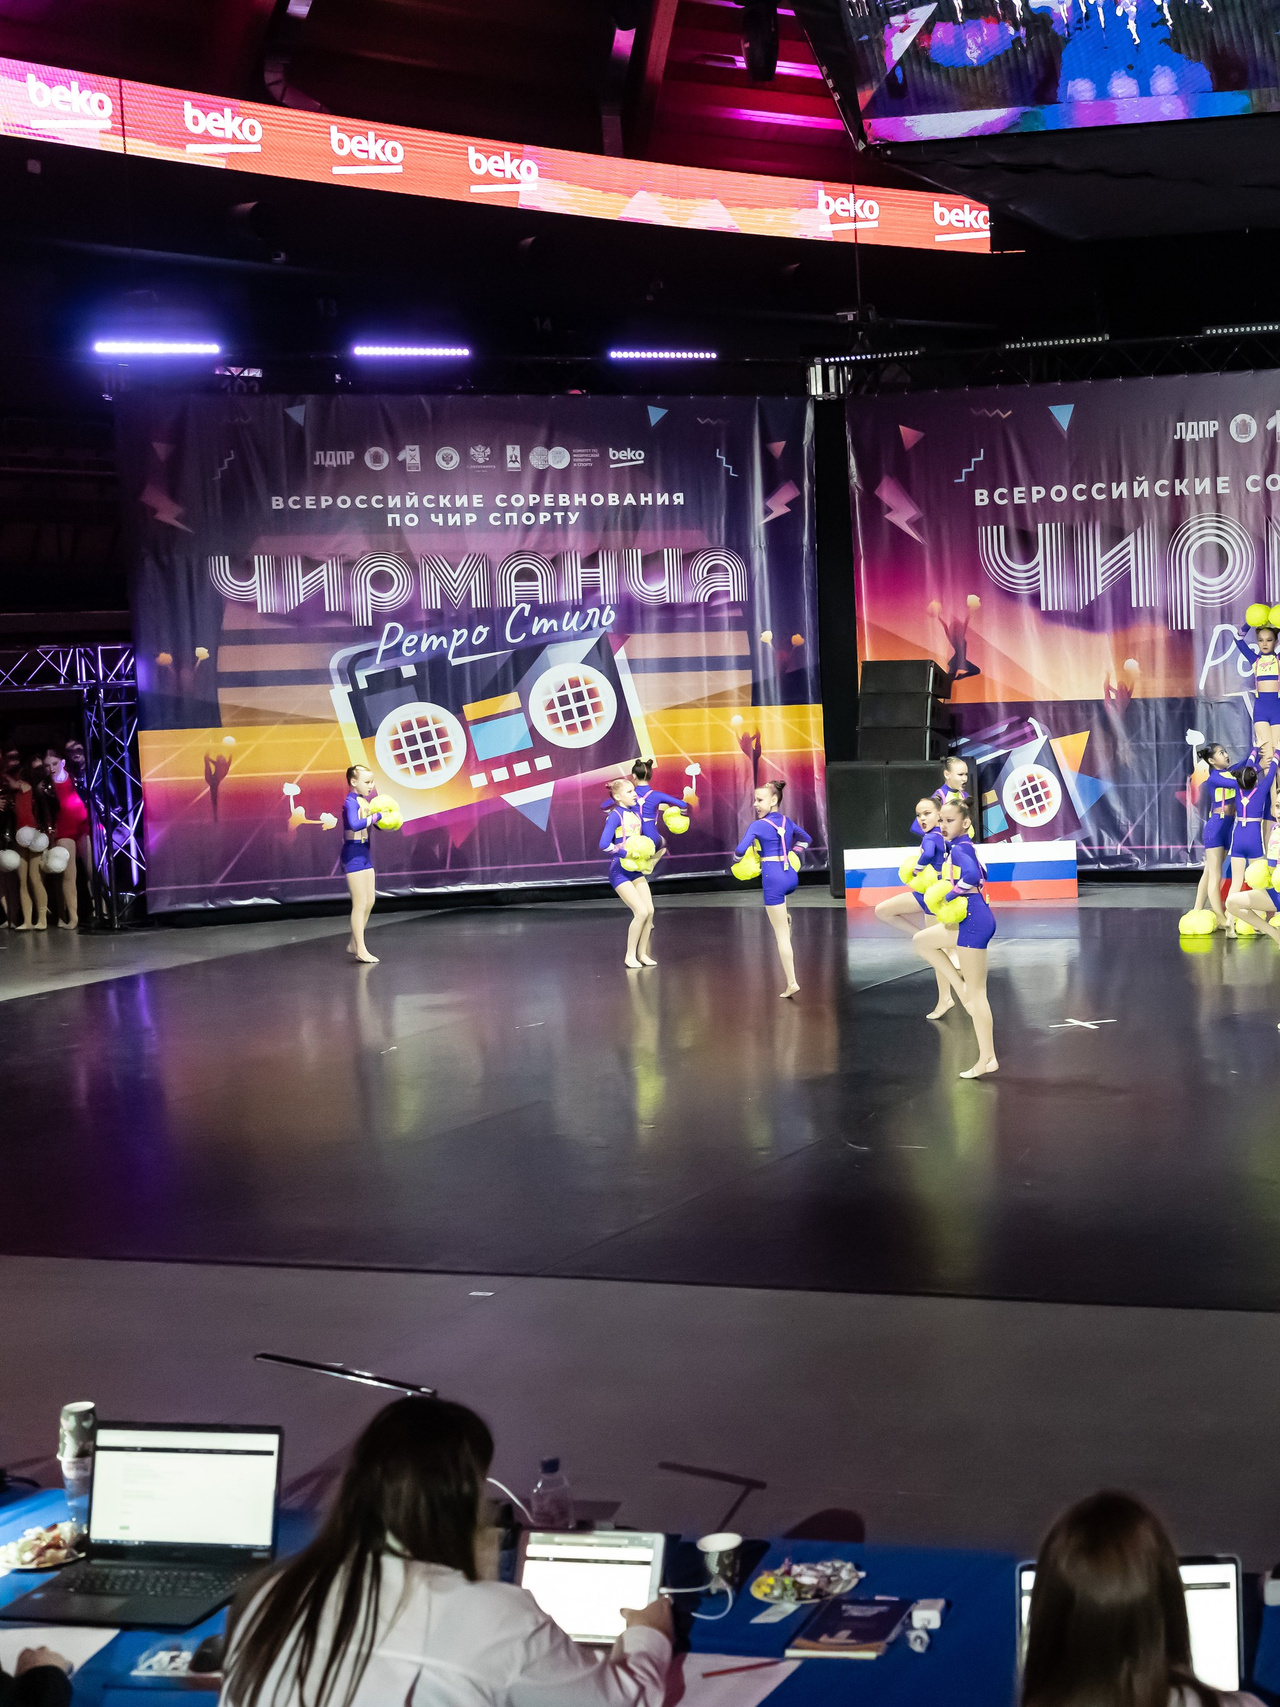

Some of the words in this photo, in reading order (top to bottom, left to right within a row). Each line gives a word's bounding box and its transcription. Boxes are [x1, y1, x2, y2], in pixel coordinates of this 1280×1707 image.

[27, 74, 113, 119] beko
[184, 102, 263, 144] beko
[330, 126, 404, 164] beko
[468, 147, 539, 182] beko
[818, 190, 880, 222] beko
[934, 201, 990, 230] beko
[533, 316, 553, 333] 14
[1173, 420, 1219, 441] ЛДПР
[314, 450, 355, 467] ЛДПР
[608, 447, 645, 460] beko
[271, 491, 484, 510] ВСЕРОССИЙСКИЕ
[495, 492, 685, 508] СОРЕВНОВАНИЯ
[975, 475, 1231, 506] ВСЕРОССИЙСКИЕ
[387, 513, 419, 528] ПО
[430, 512, 478, 527] ЧИР
[488, 510, 580, 527] СПОРТУ
[375, 620, 490, 665] Ретро
[505, 602, 617, 644] Стиль
